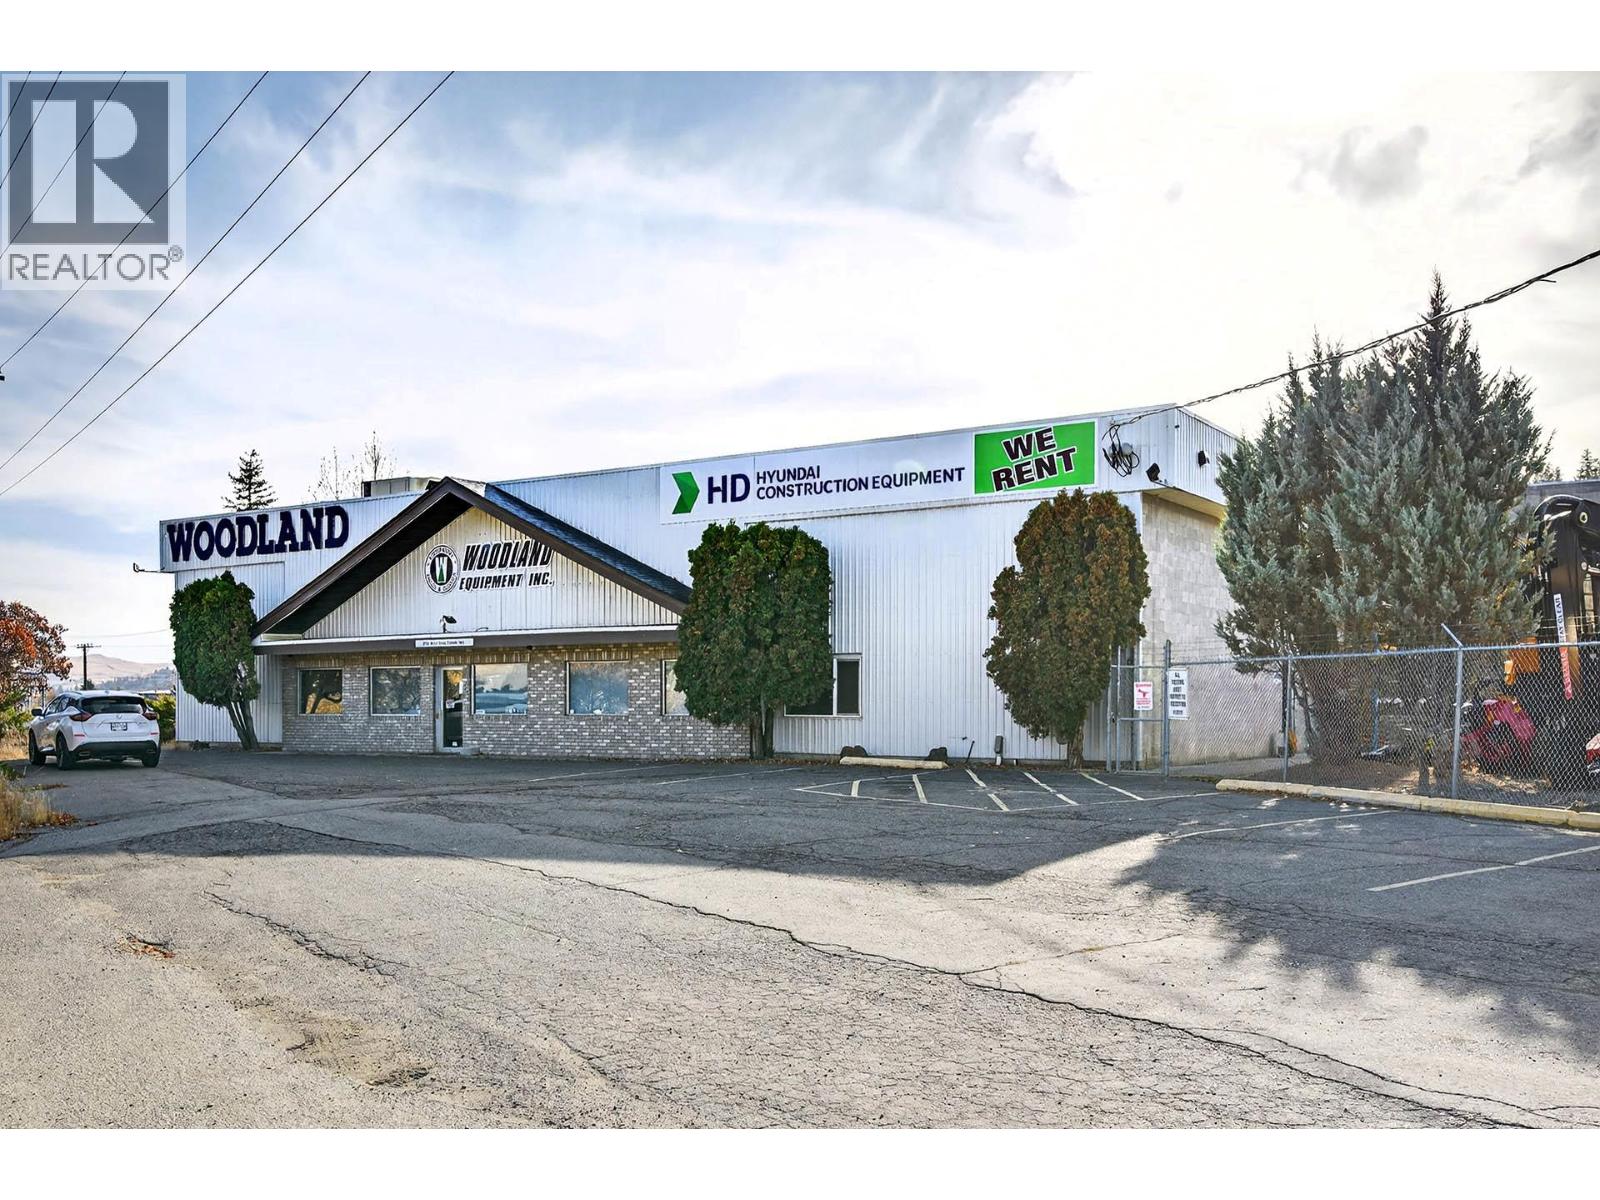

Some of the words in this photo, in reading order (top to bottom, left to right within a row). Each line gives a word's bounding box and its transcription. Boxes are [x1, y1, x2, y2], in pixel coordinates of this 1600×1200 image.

[1002, 427, 1056, 461] WE
[756, 465, 821, 485] HYUNDAI
[757, 477, 868, 500] CONSTRUCTION
[872, 467, 965, 490] EQUIPMENT
[992, 447, 1076, 492] RENT
[707, 473, 750, 504] HD
[167, 505, 349, 562] WOODLAND
[462, 539, 553, 571] WOODLAND
[459, 573, 523, 591] EQUIPMENT
[528, 572, 553, 587] INC.
